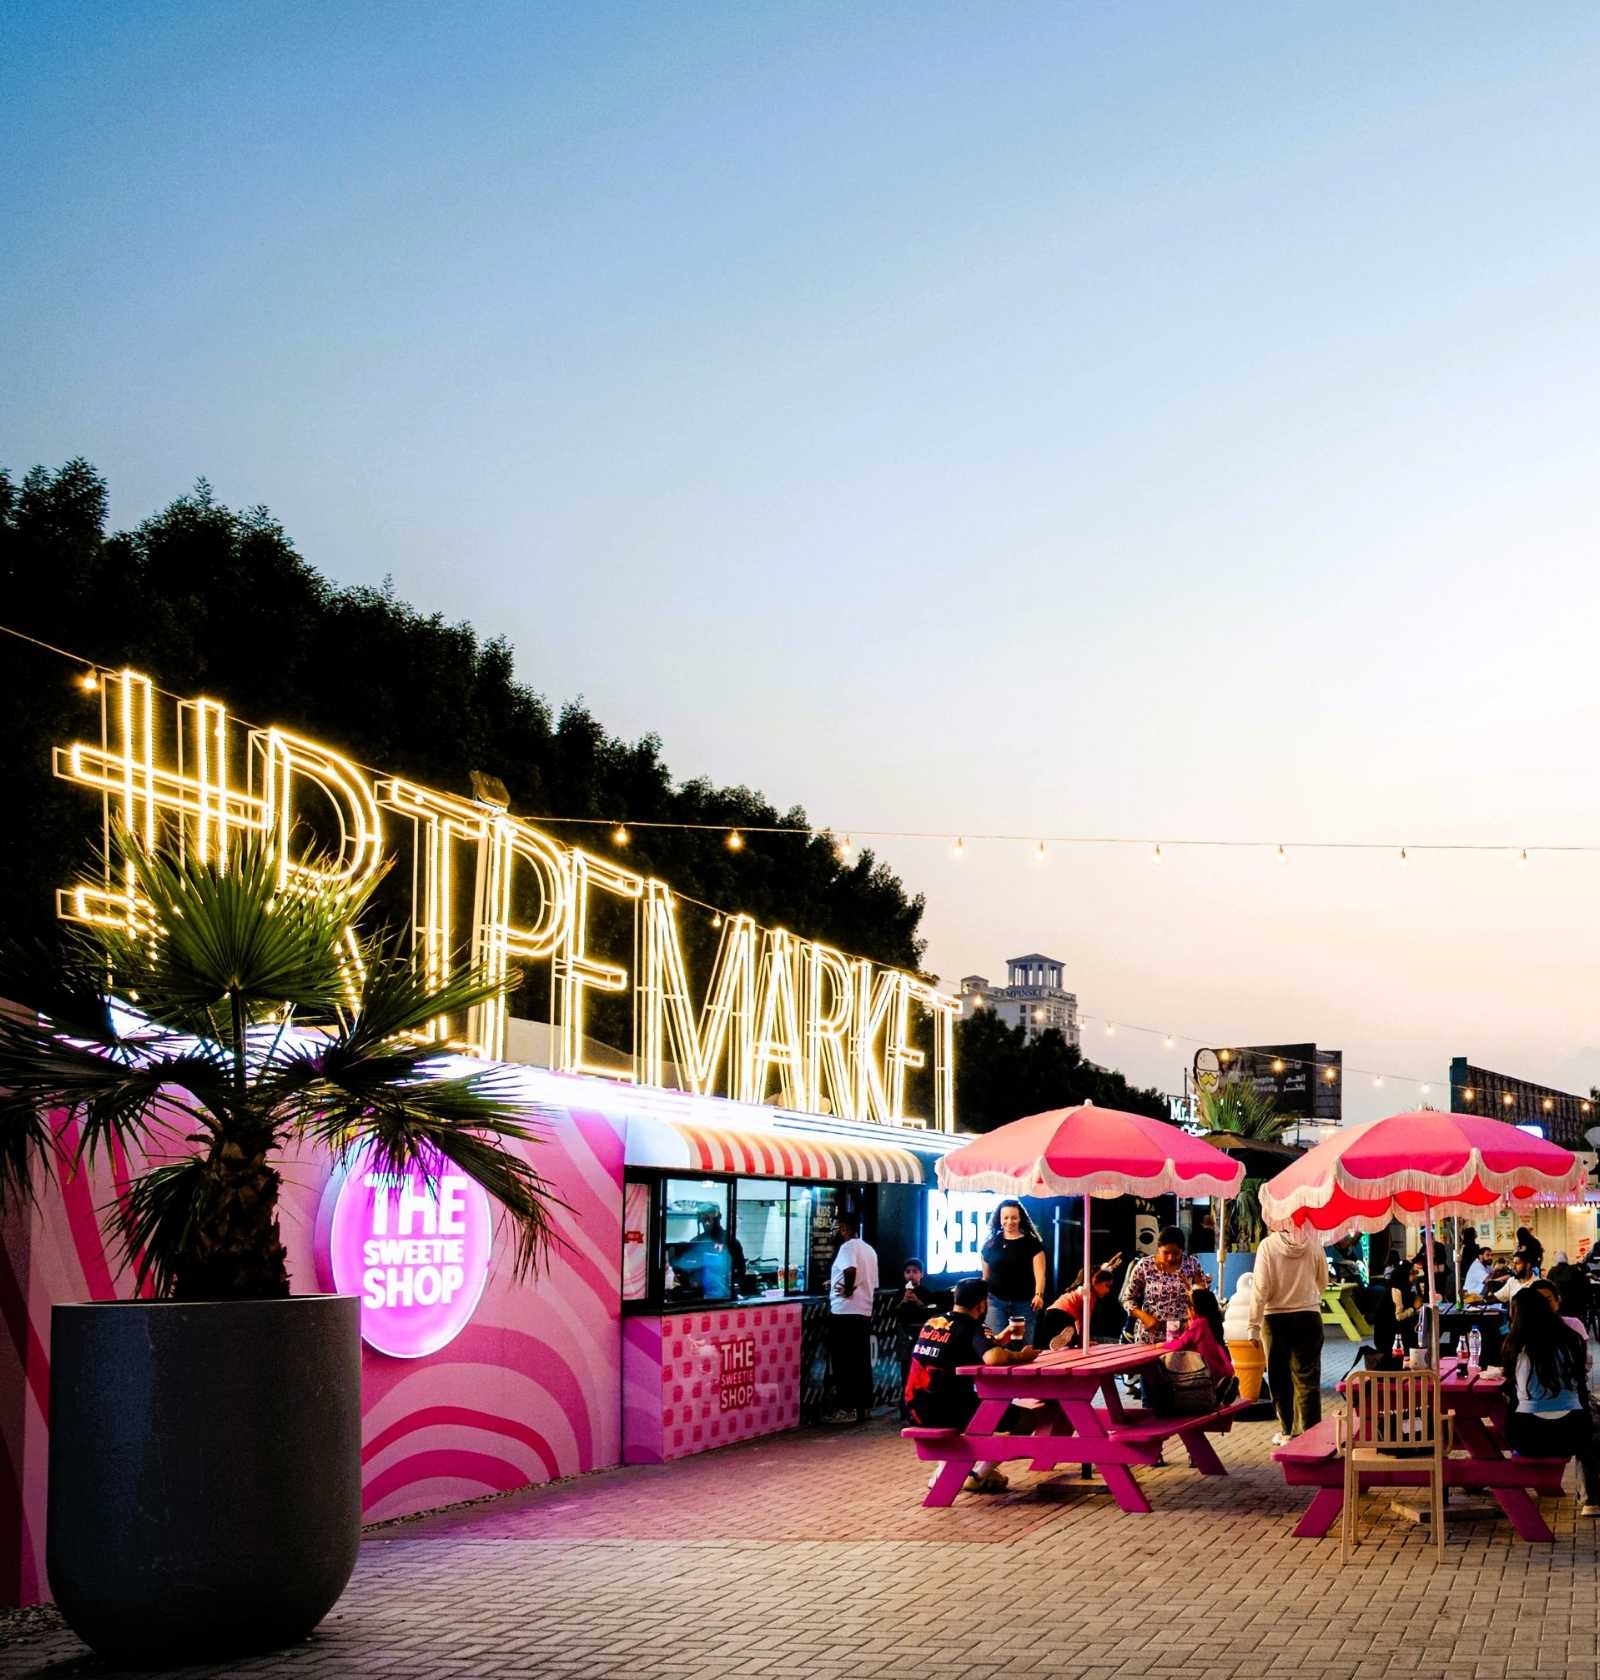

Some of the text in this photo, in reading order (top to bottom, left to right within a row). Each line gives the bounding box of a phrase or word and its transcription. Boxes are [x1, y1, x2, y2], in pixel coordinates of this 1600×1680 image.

[364, 1173, 468, 1235] THE
[363, 1239, 464, 1266] SWEETIE
[363, 1265, 464, 1310] SHOP
[931, 1330, 951, 1343] Bull
[720, 1340, 754, 1371] THE
[720, 1370, 754, 1387] SWEETIE
[720, 1385, 754, 1409] SHOP
